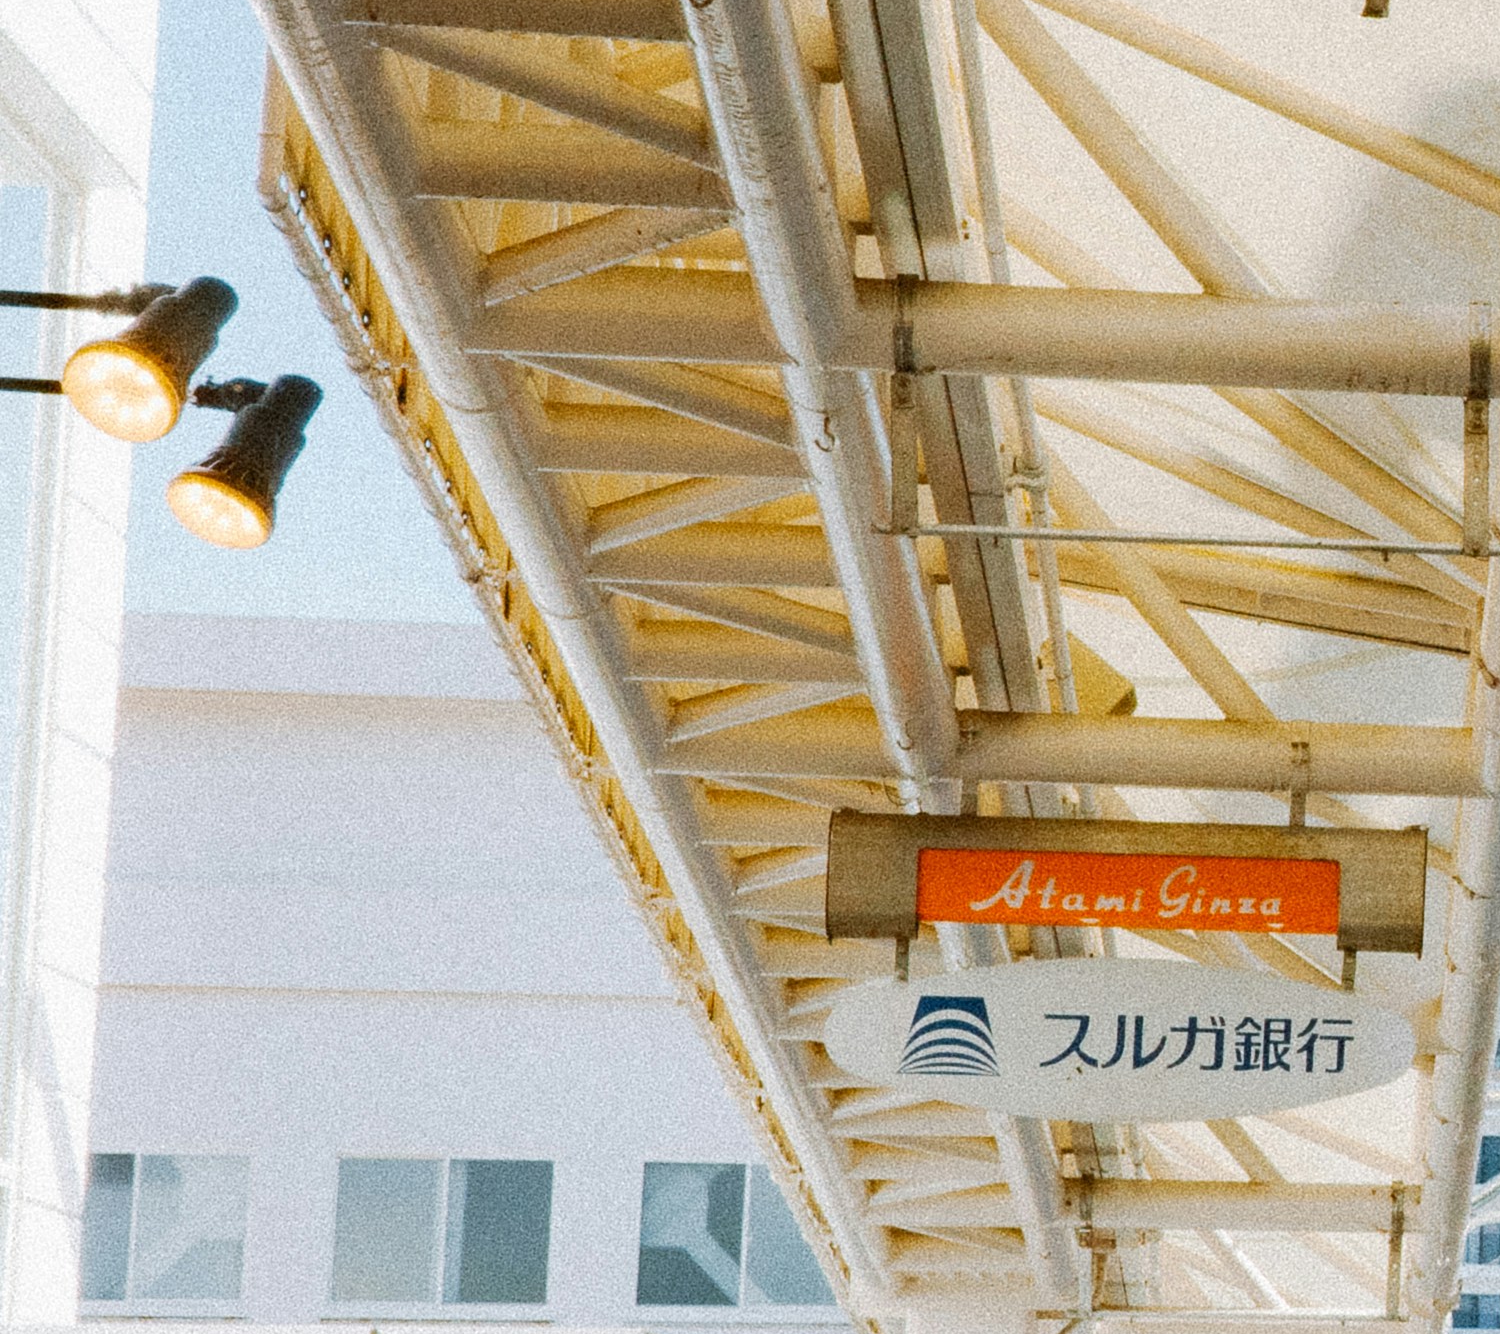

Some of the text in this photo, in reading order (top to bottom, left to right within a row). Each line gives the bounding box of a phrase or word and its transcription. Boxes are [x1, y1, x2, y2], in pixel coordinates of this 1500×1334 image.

[969, 860, 1281, 919] Atami Ginza
[1038, 1013, 1355, 1073] スルガ銀行
